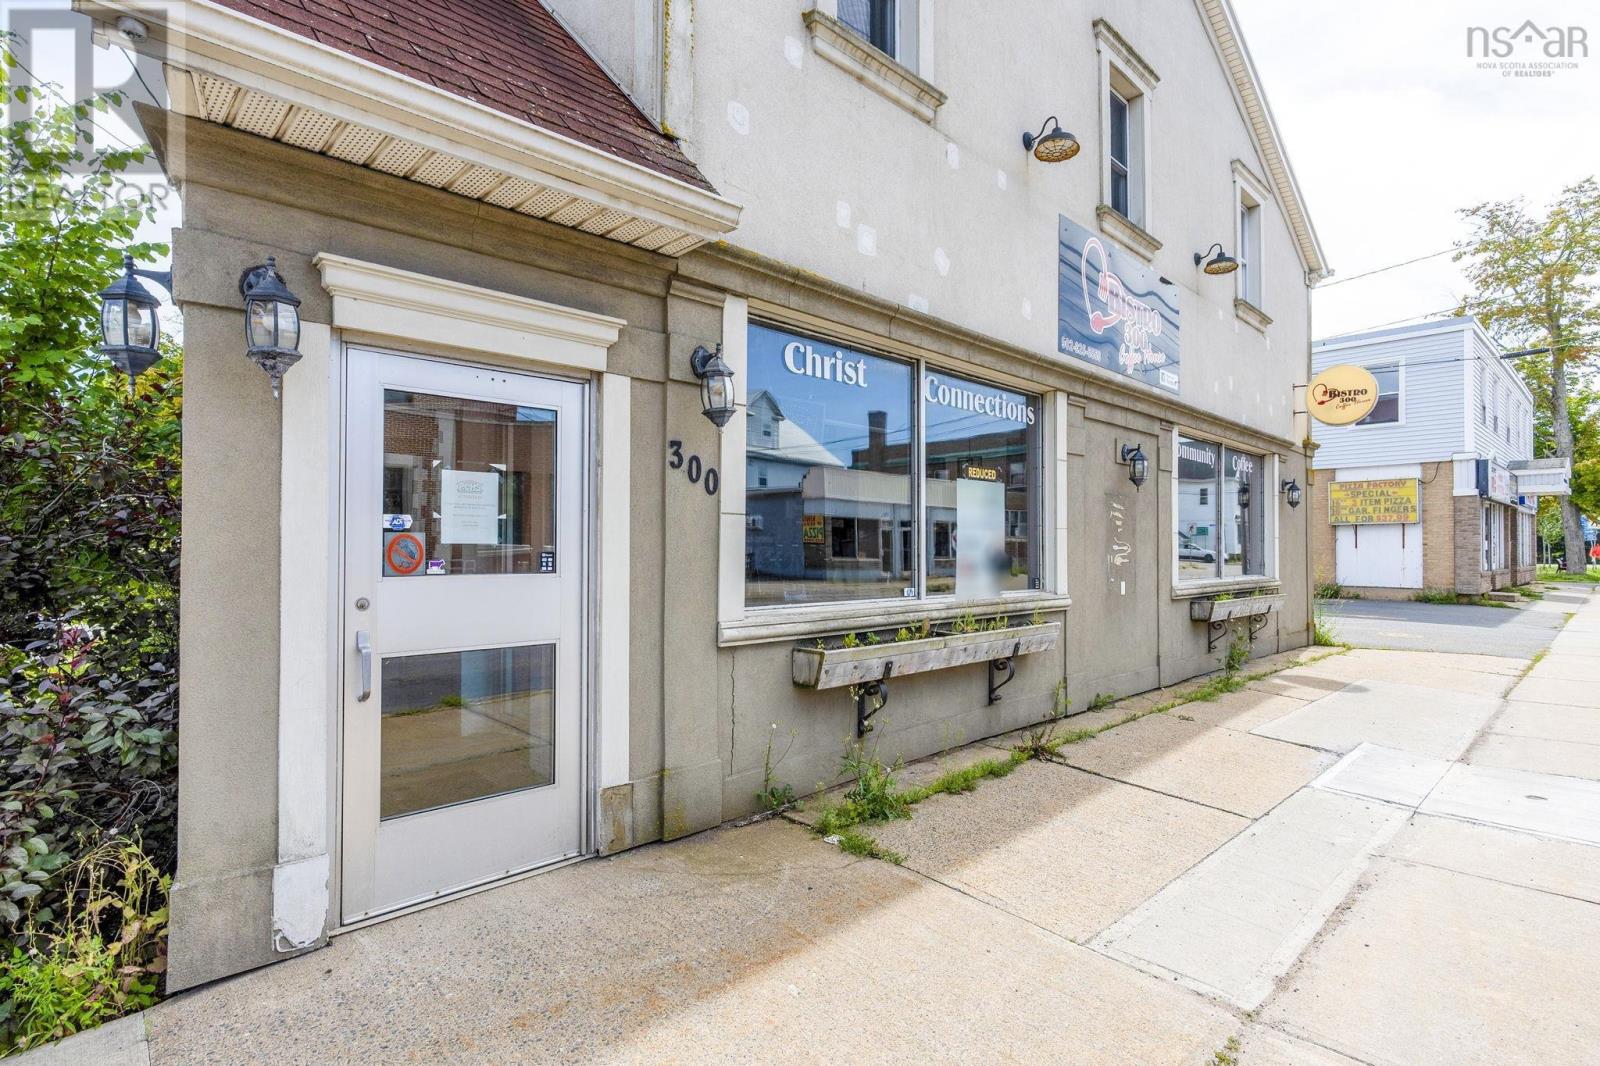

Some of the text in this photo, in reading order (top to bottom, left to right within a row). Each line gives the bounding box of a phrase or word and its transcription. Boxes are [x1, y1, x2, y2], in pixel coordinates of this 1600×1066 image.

[1125, 322, 1148, 352] 300
[784, 341, 868, 388] Christ
[925, 375, 1035, 425] Connections
[1328, 388, 1368, 398] BISTRO
[1339, 396, 1357, 404] 300
[669, 440, 719, 496] 300
[1232, 454, 1253, 473] Coffee
[968, 466, 997, 480] REDUCED
[1360, 498, 1381, 506] ITEM
[1384, 496, 1412, 505] PIZZA
[1373, 504, 1416, 514] FINGERS
[1355, 514, 1374, 522] FOR
